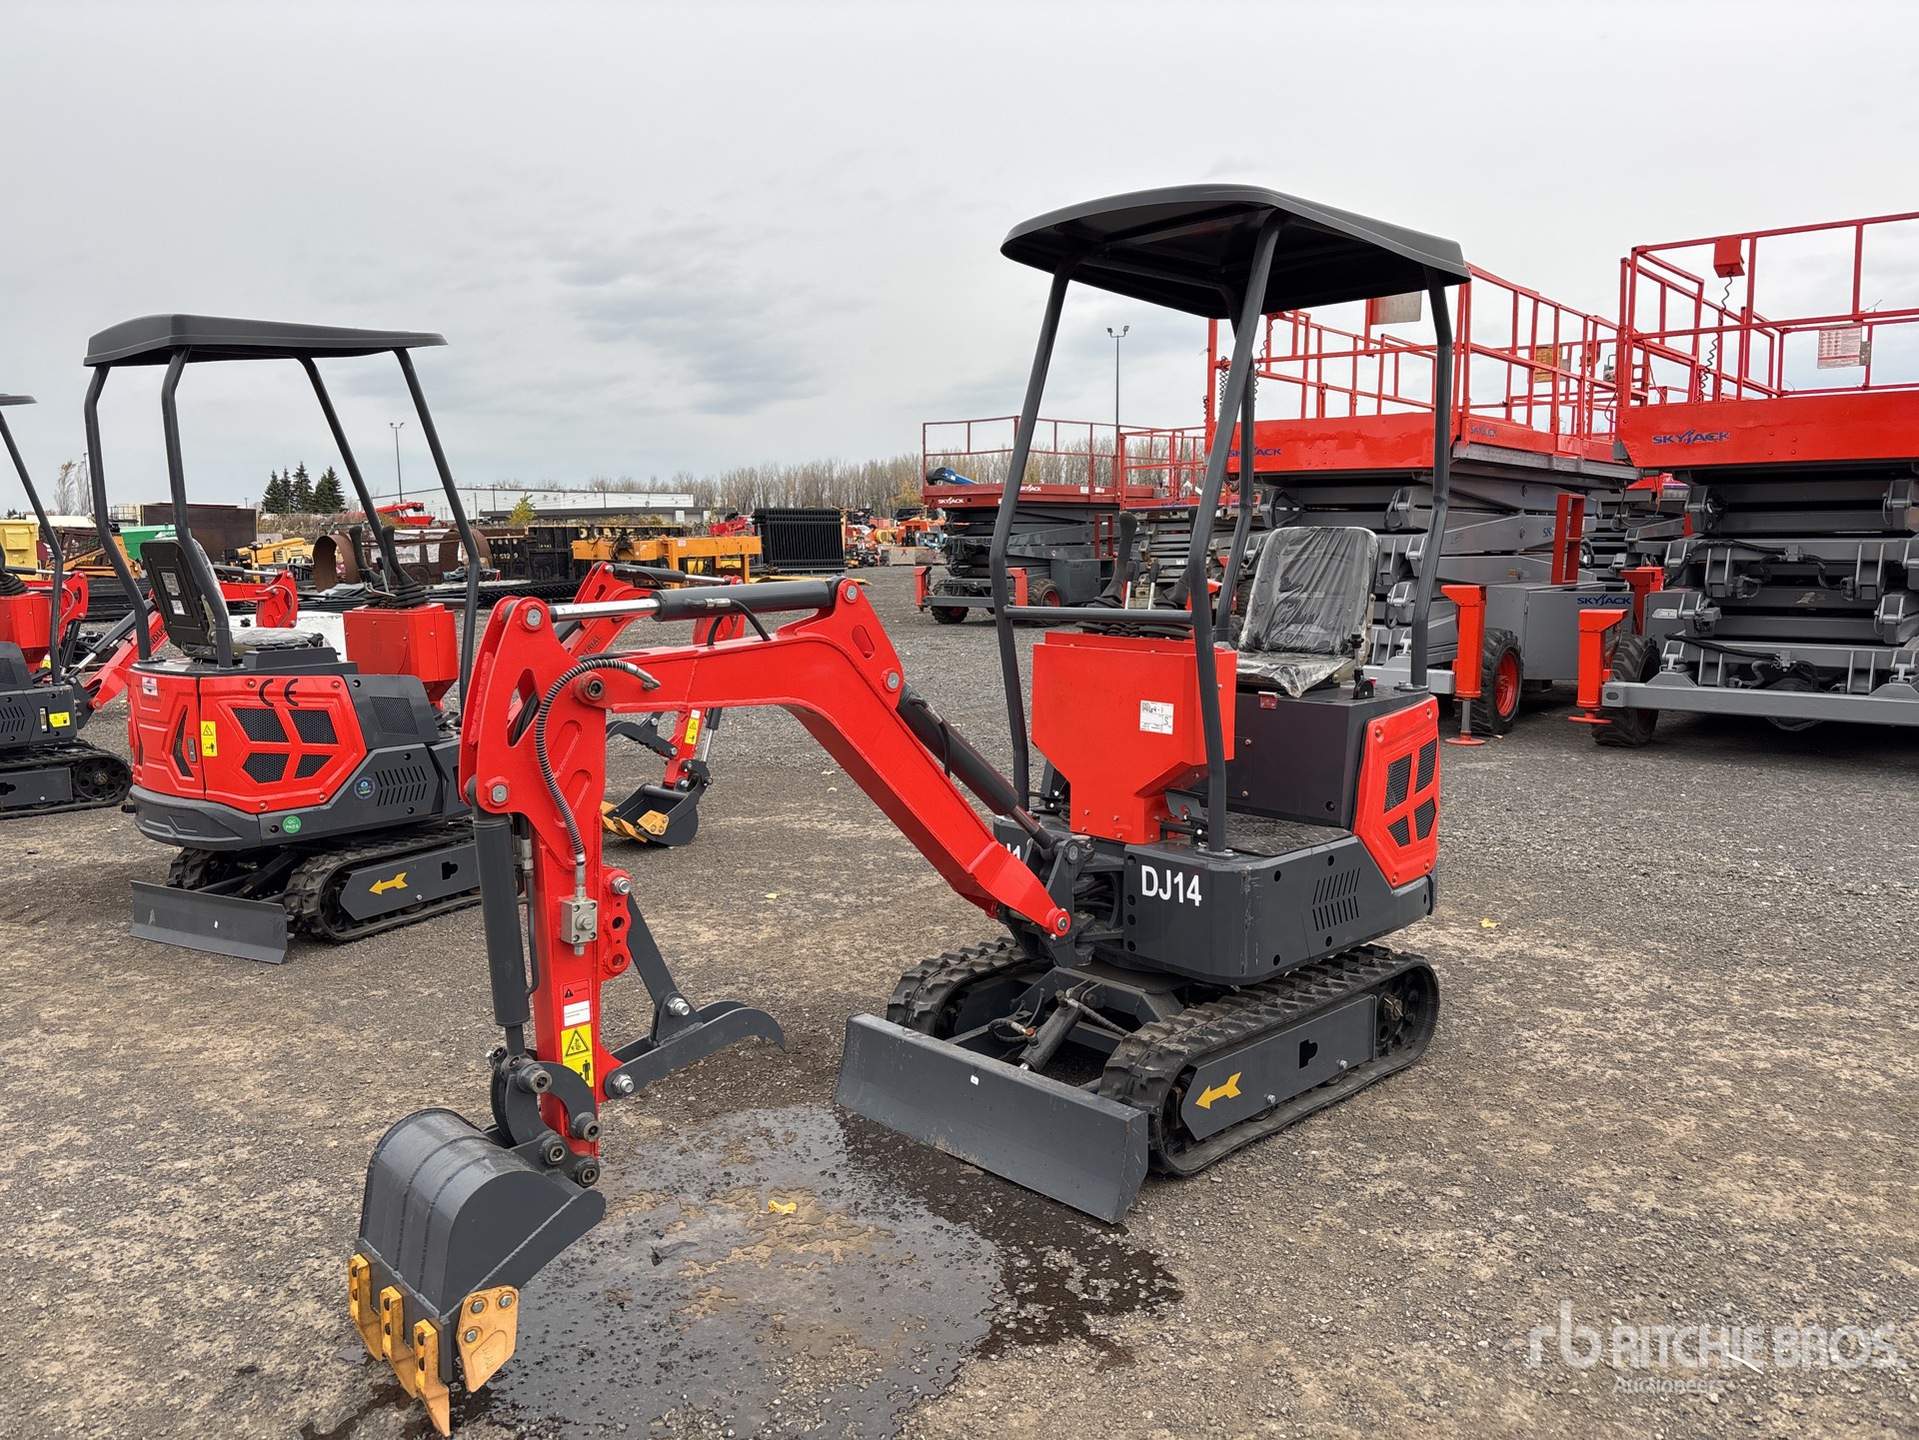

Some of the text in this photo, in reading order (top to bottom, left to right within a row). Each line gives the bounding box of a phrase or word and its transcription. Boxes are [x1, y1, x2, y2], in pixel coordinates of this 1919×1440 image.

[1652, 429, 1730, 445] SKYJACK
[1228, 446, 1282, 457] SKACK
[938, 496, 965, 505] SKYJACK
[1577, 594, 1631, 606] SKYJACK
[259, 678, 299, 707] CE
[1141, 865, 1202, 907] DJ14
